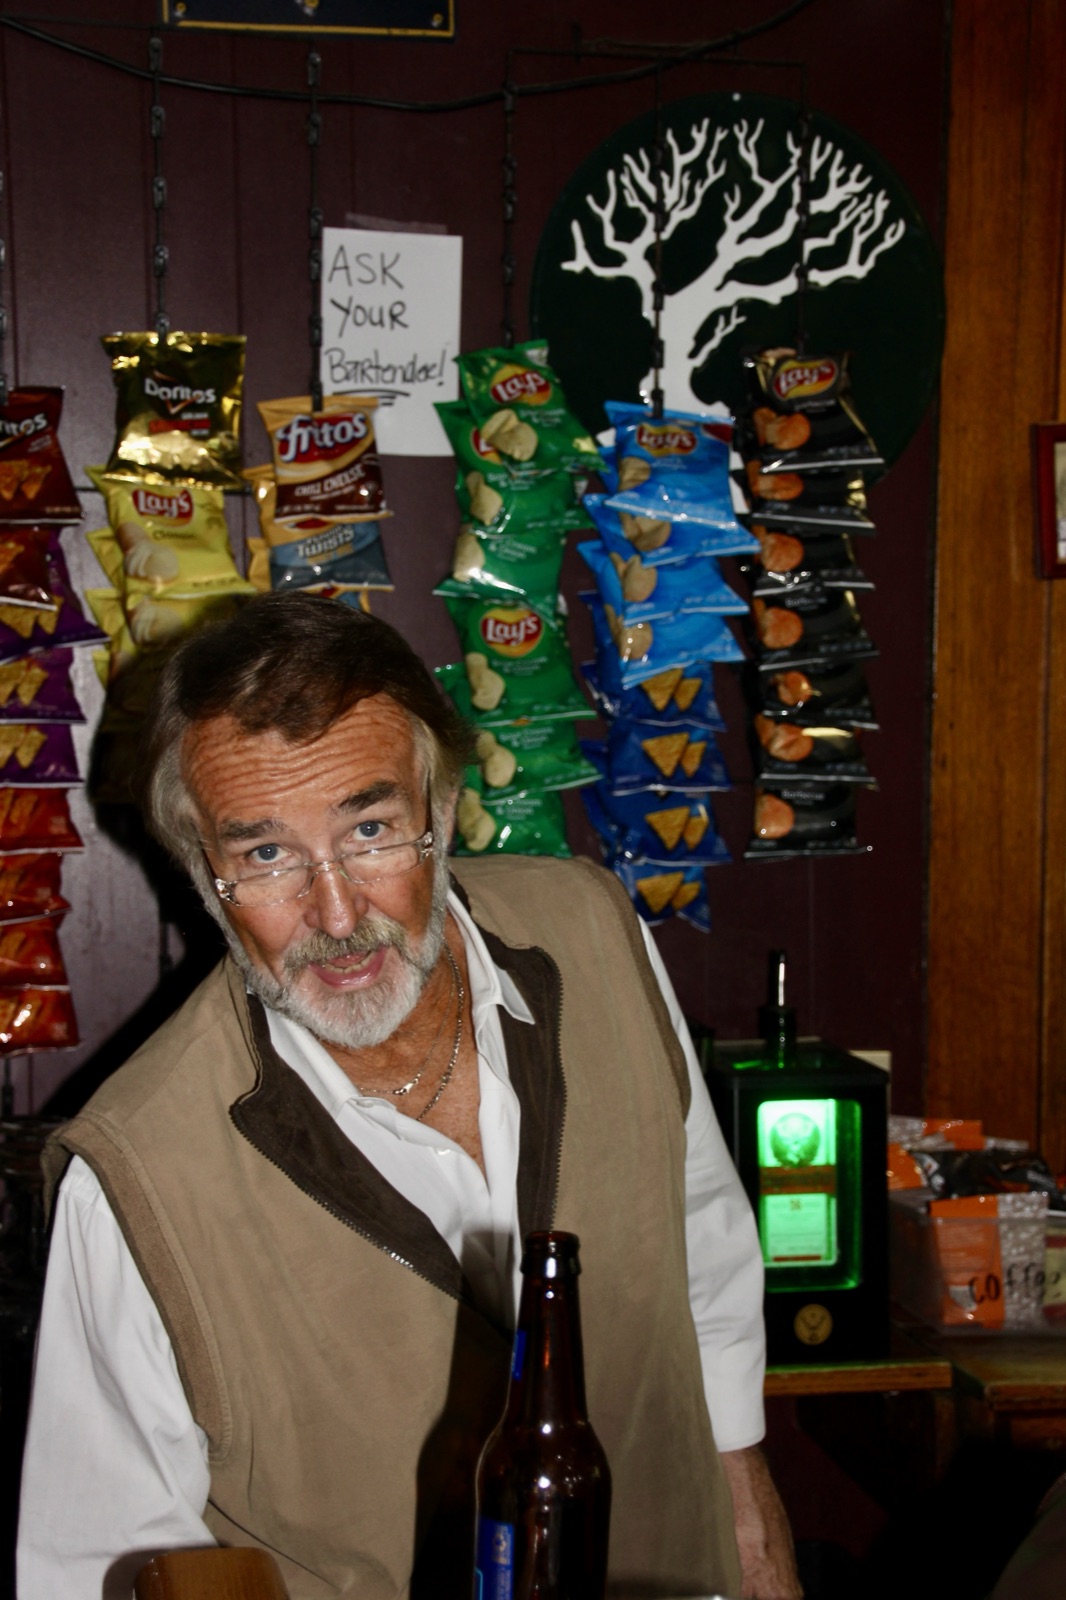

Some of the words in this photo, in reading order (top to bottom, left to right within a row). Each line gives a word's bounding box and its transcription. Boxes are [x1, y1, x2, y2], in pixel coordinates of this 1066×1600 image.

[327, 244, 404, 289] ASK
[329, 296, 409, 338] YOUR
[144, 377, 216, 404] Doritos
[495, 372, 546, 402] Lay's
[779, 364, 832, 395] Lay's
[640, 429, 693, 448] Lay's
[137, 489, 191, 518] Lay's
[485, 613, 540, 647] Lay's
